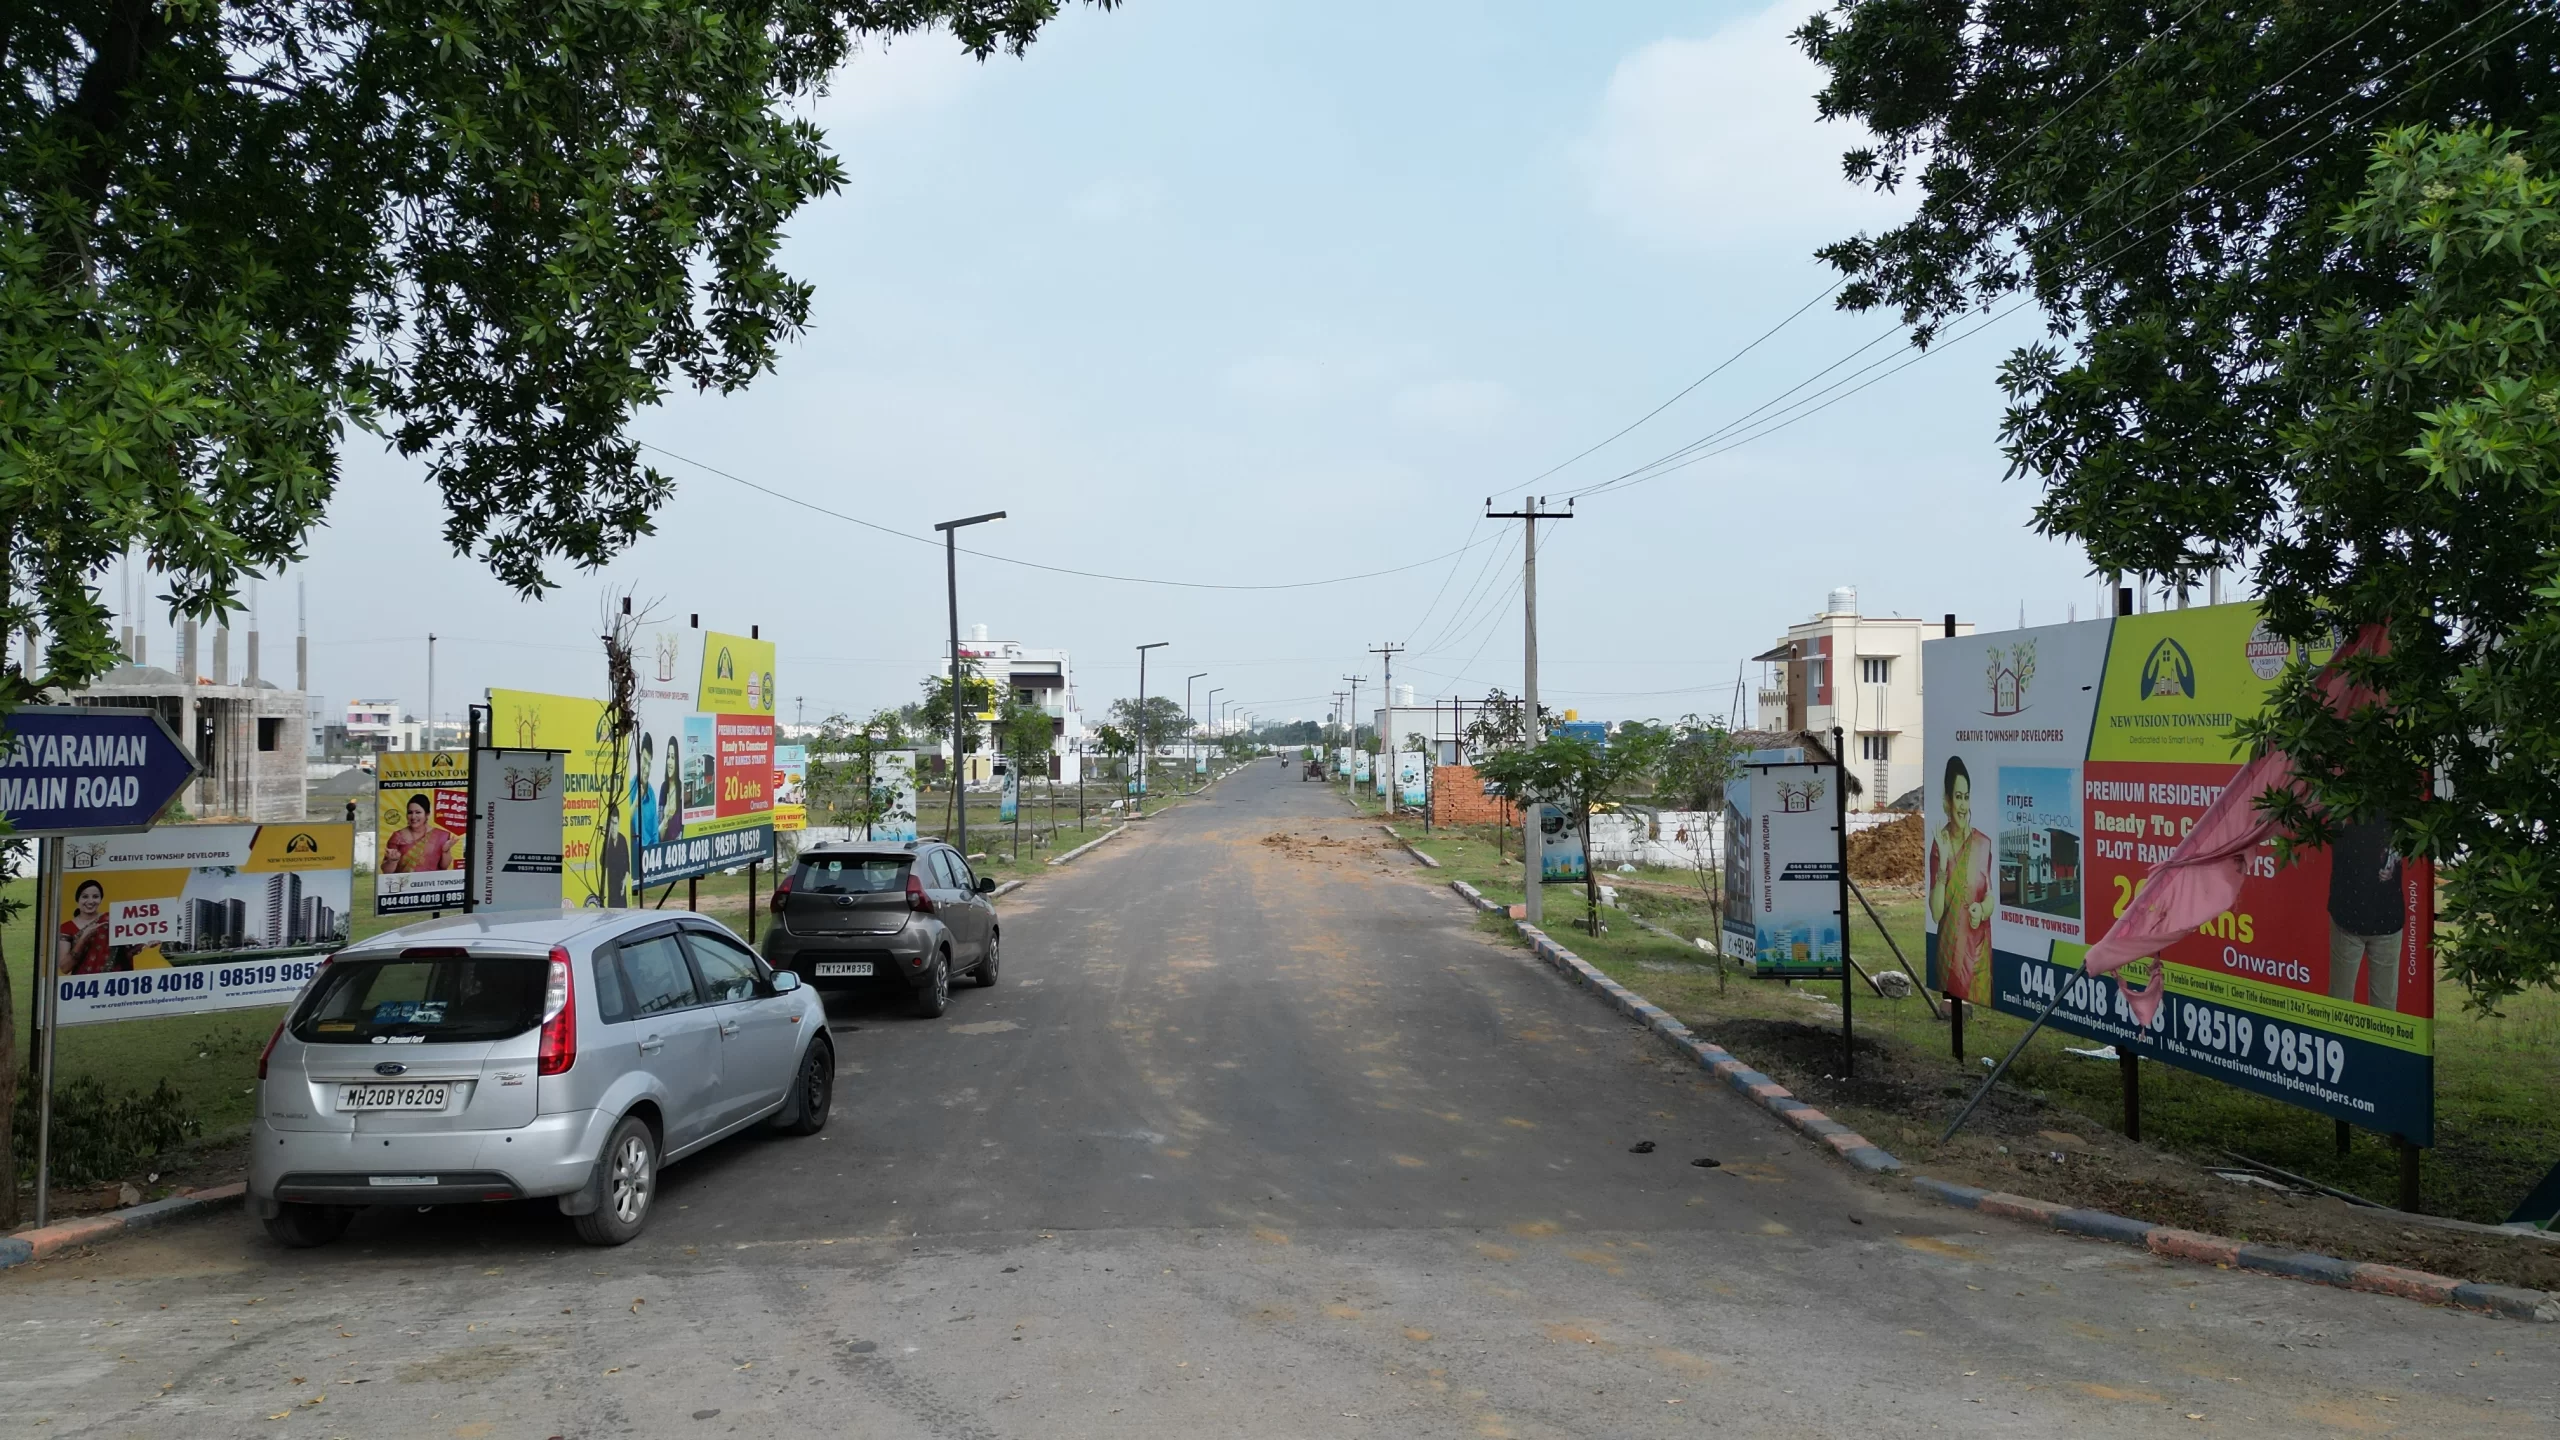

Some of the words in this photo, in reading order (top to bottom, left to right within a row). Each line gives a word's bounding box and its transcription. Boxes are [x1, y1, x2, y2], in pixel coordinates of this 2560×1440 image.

[2247, 642, 2289, 656] APPROVED
[2110, 715, 2133, 728] NEW
[2134, 714, 2170, 728] VISION
[2172, 713, 2233, 727] TOWNSHIP
[1955, 730, 1983, 742] CREATIVE
[1985, 730, 2019, 742] TOWNSHIP
[2021, 729, 2064, 742] DEVELOPERS
[2130, 736, 2160, 744] Dedicated
[2161, 736, 2167, 744] to
[2169, 735, 2186, 744] Smart
[2187, 735, 2204, 746] Living
[410, 769, 444, 778] VISION
[563, 774, 600, 793] DENTIAL
[0, 777, 68, 810] MAIN
[74, 776, 139, 808] ROAD
[724, 776, 738, 801] 20
[740, 780, 761, 799] Lakhs
[2085, 780, 2145, 803] PREMIUM
[2149, 783, 2227, 807] RESIDENT
[2006, 795, 2034, 809] FIITJEE
[487, 801, 495, 840] DEVELOPERS
[570, 815, 592, 827] STARTS
[2006, 811, 2037, 826] GLOBAL
[2039, 813, 2074, 828] SCHOOL
[2094, 810, 2146, 838] Ready
[2151, 814, 2175, 838] To
[1762, 814, 1770, 851] DEVELOPERS
[109, 853, 143, 862] CREATIVE
[146, 851, 184, 861] TOWNSHIP
[187, 851, 230, 859] DEVELOPERS
[486, 840, 494, 874] TOWNSHIP
[562, 840, 590, 858] akhs
[642, 847, 662, 874] 044
[665, 843, 687, 868] 4018
[689, 838, 709, 863] 4018
[715, 833, 738, 858] 98519
[740, 829, 761, 854] 98519
[2097, 839, 2134, 861] PLOT
[1763, 852, 1771, 884] TOWNSHIP
[410, 880, 435, 888] CREATIVE
[485, 876, 493, 905] CREATIVE
[2408, 880, 2418, 913] Apply
[122, 904, 160, 919] MSB
[380, 897, 397, 906] 044
[398, 895, 418, 904] 4018
[420, 893, 440, 903] 4018
[1764, 885, 1772, 913] CREATIVE
[114, 921, 169, 938] PLOTS
[2001, 911, 2024, 925] INSIDE
[2025, 915, 2039, 928] THE
[2041, 918, 2080, 936] TOWNSHIP
[2408, 915, 2416, 976] Conditions
[2223, 945, 2310, 983] Onwards
[60, 979, 100, 1001] 044
[104, 975, 153, 996] 4018
[157, 971, 204, 993] 4018
[219, 965, 276, 988] 98519
[281, 961, 322, 982] 985
[2127, 964, 2138, 974] Park
[2170, 974, 2189, 986] Potable
[2190, 979, 2208, 991] Ground
[2209, 982, 2224, 994] Water
[2231, 986, 2245, 998] Clear
[2246, 990, 2258, 1002] Title
[2259, 994, 2286, 1009] document
[2290, 1002, 2305, 1014] 24x7
[2306, 1004, 2331, 1022] Security
[2396, 1023, 2414, 1040] Road
[2020, 961, 2056, 1001] 044
[2063, 972, 2107, 1016] 4018
[2183, 1002, 2253, 1058] 98519
[2264, 1023, 2345, 1084] 98519
[2002, 990, 2022, 1006] Email:
[2167, 1038, 2188, 1056] Web:
[2190, 1048, 2375, 1114] www.creativetownshipdevelopers.com
[380, 1064, 398, 1073] Ford
[346, 1088, 445, 1106] MH20BY8209
